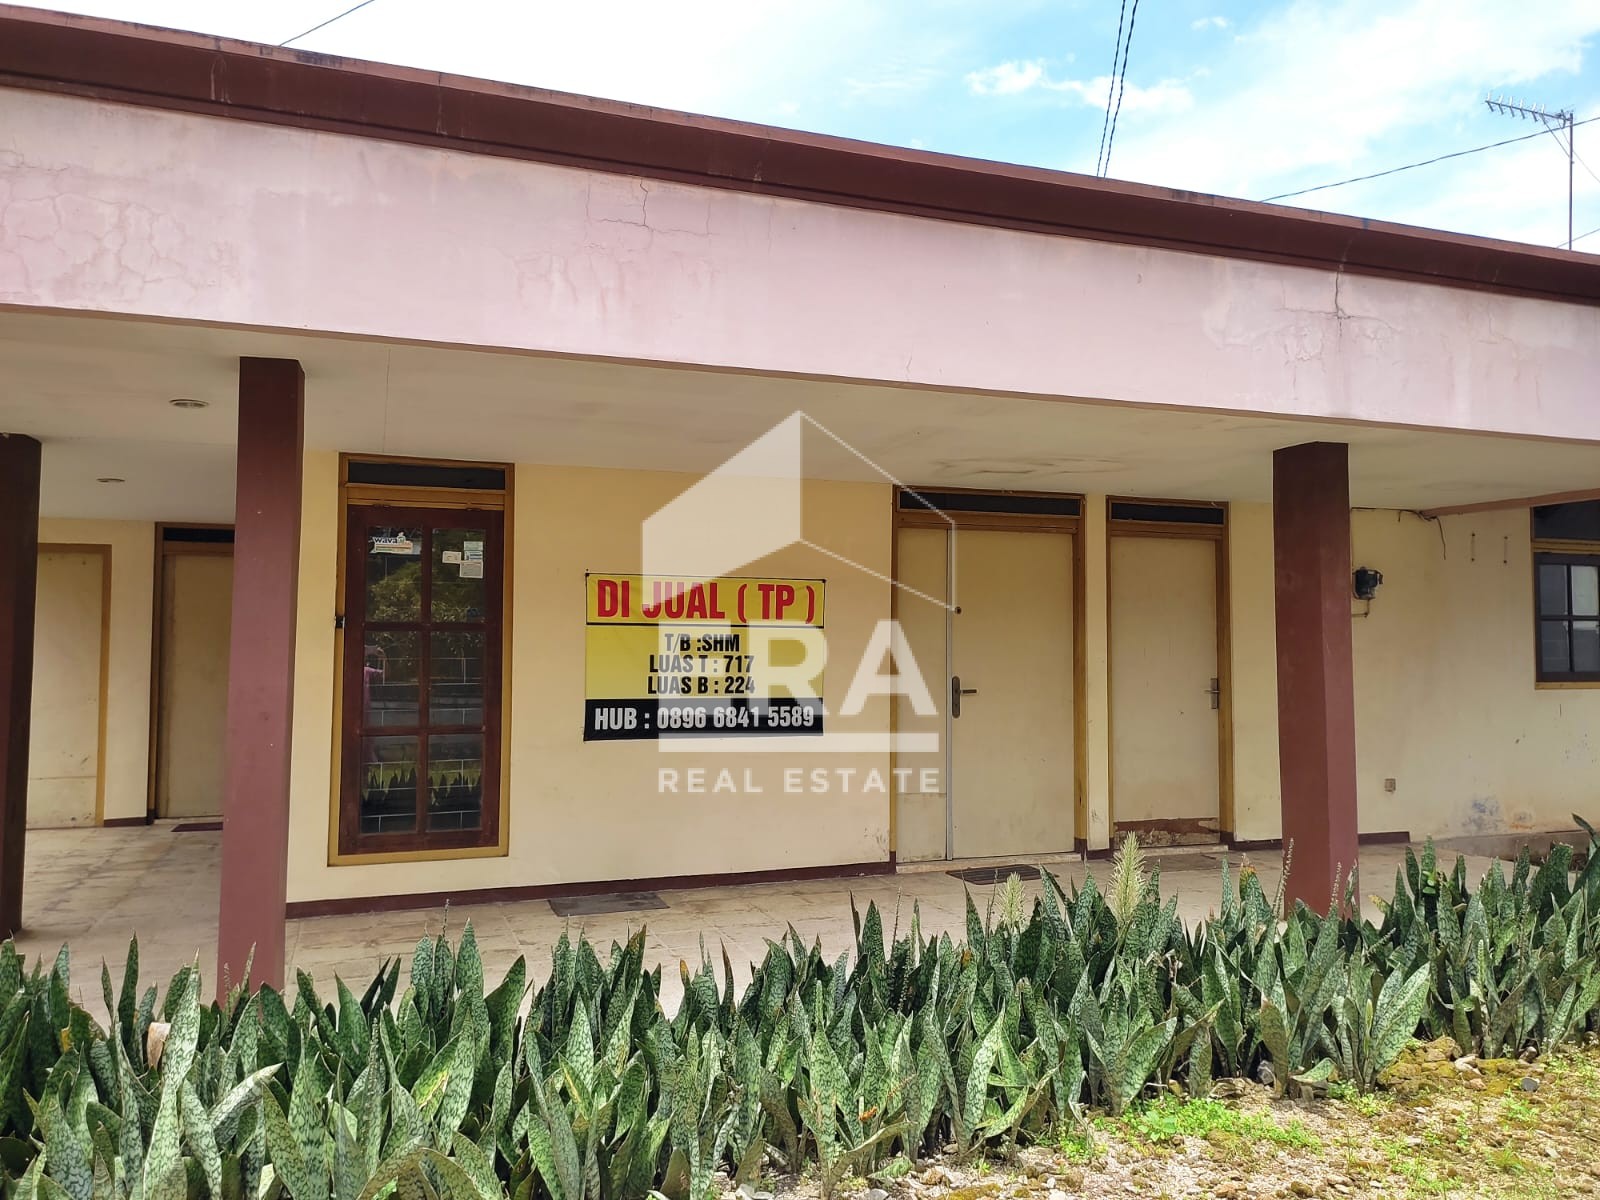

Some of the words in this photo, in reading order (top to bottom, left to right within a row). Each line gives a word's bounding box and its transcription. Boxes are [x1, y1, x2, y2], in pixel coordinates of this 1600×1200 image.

[597, 579, 630, 618] DI
[642, 581, 726, 619] JUAL
[737, 583, 748, 623] (
[757, 584, 795, 620] TP
[805, 585, 815, 624] )
[664, 633, 691, 653] T/B
[649, 655, 693, 673] LUAS
[698, 655, 708, 672] T
[723, 655, 755, 673] 717
[648, 676, 692, 694] LUAS
[697, 676, 708, 694] B
[724, 676, 755, 694] 224
[594, 707, 638, 730] HUB
[656, 706, 707, 729] 0896
[713, 705, 759, 728] 6841
[767, 705, 814, 727] 5589
